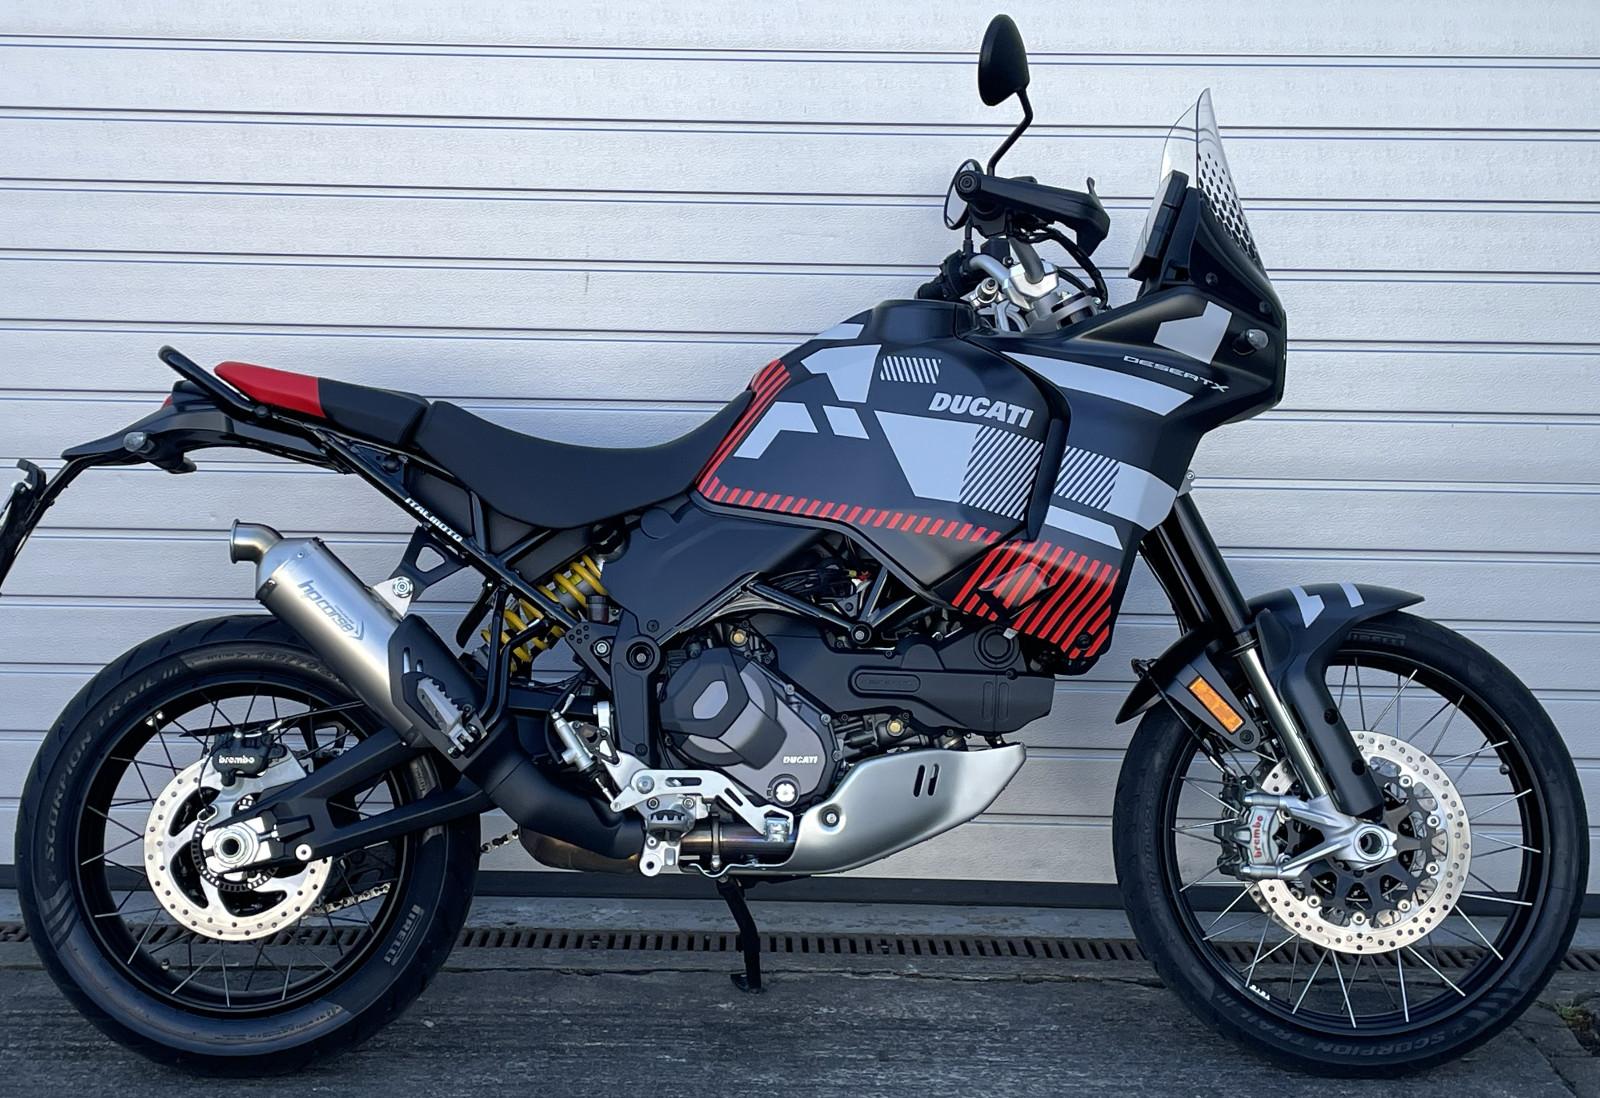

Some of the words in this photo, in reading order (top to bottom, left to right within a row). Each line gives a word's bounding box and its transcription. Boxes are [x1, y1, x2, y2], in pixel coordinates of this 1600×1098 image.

[928, 392, 1034, 428] DUCATI
[404, 497, 463, 543] ITALMOTO
[46, 731, 92, 862] SCORPION
[97, 679, 159, 728] TRAIL
[218, 754, 256, 764] brembo
[782, 755, 818, 764] DUCATI
[1252, 815, 1264, 858] brembo
[383, 904, 424, 966] PIRELLI
[1241, 1010, 1305, 1047] TRAIL
[1313, 1032, 1446, 1057] SCORPION
